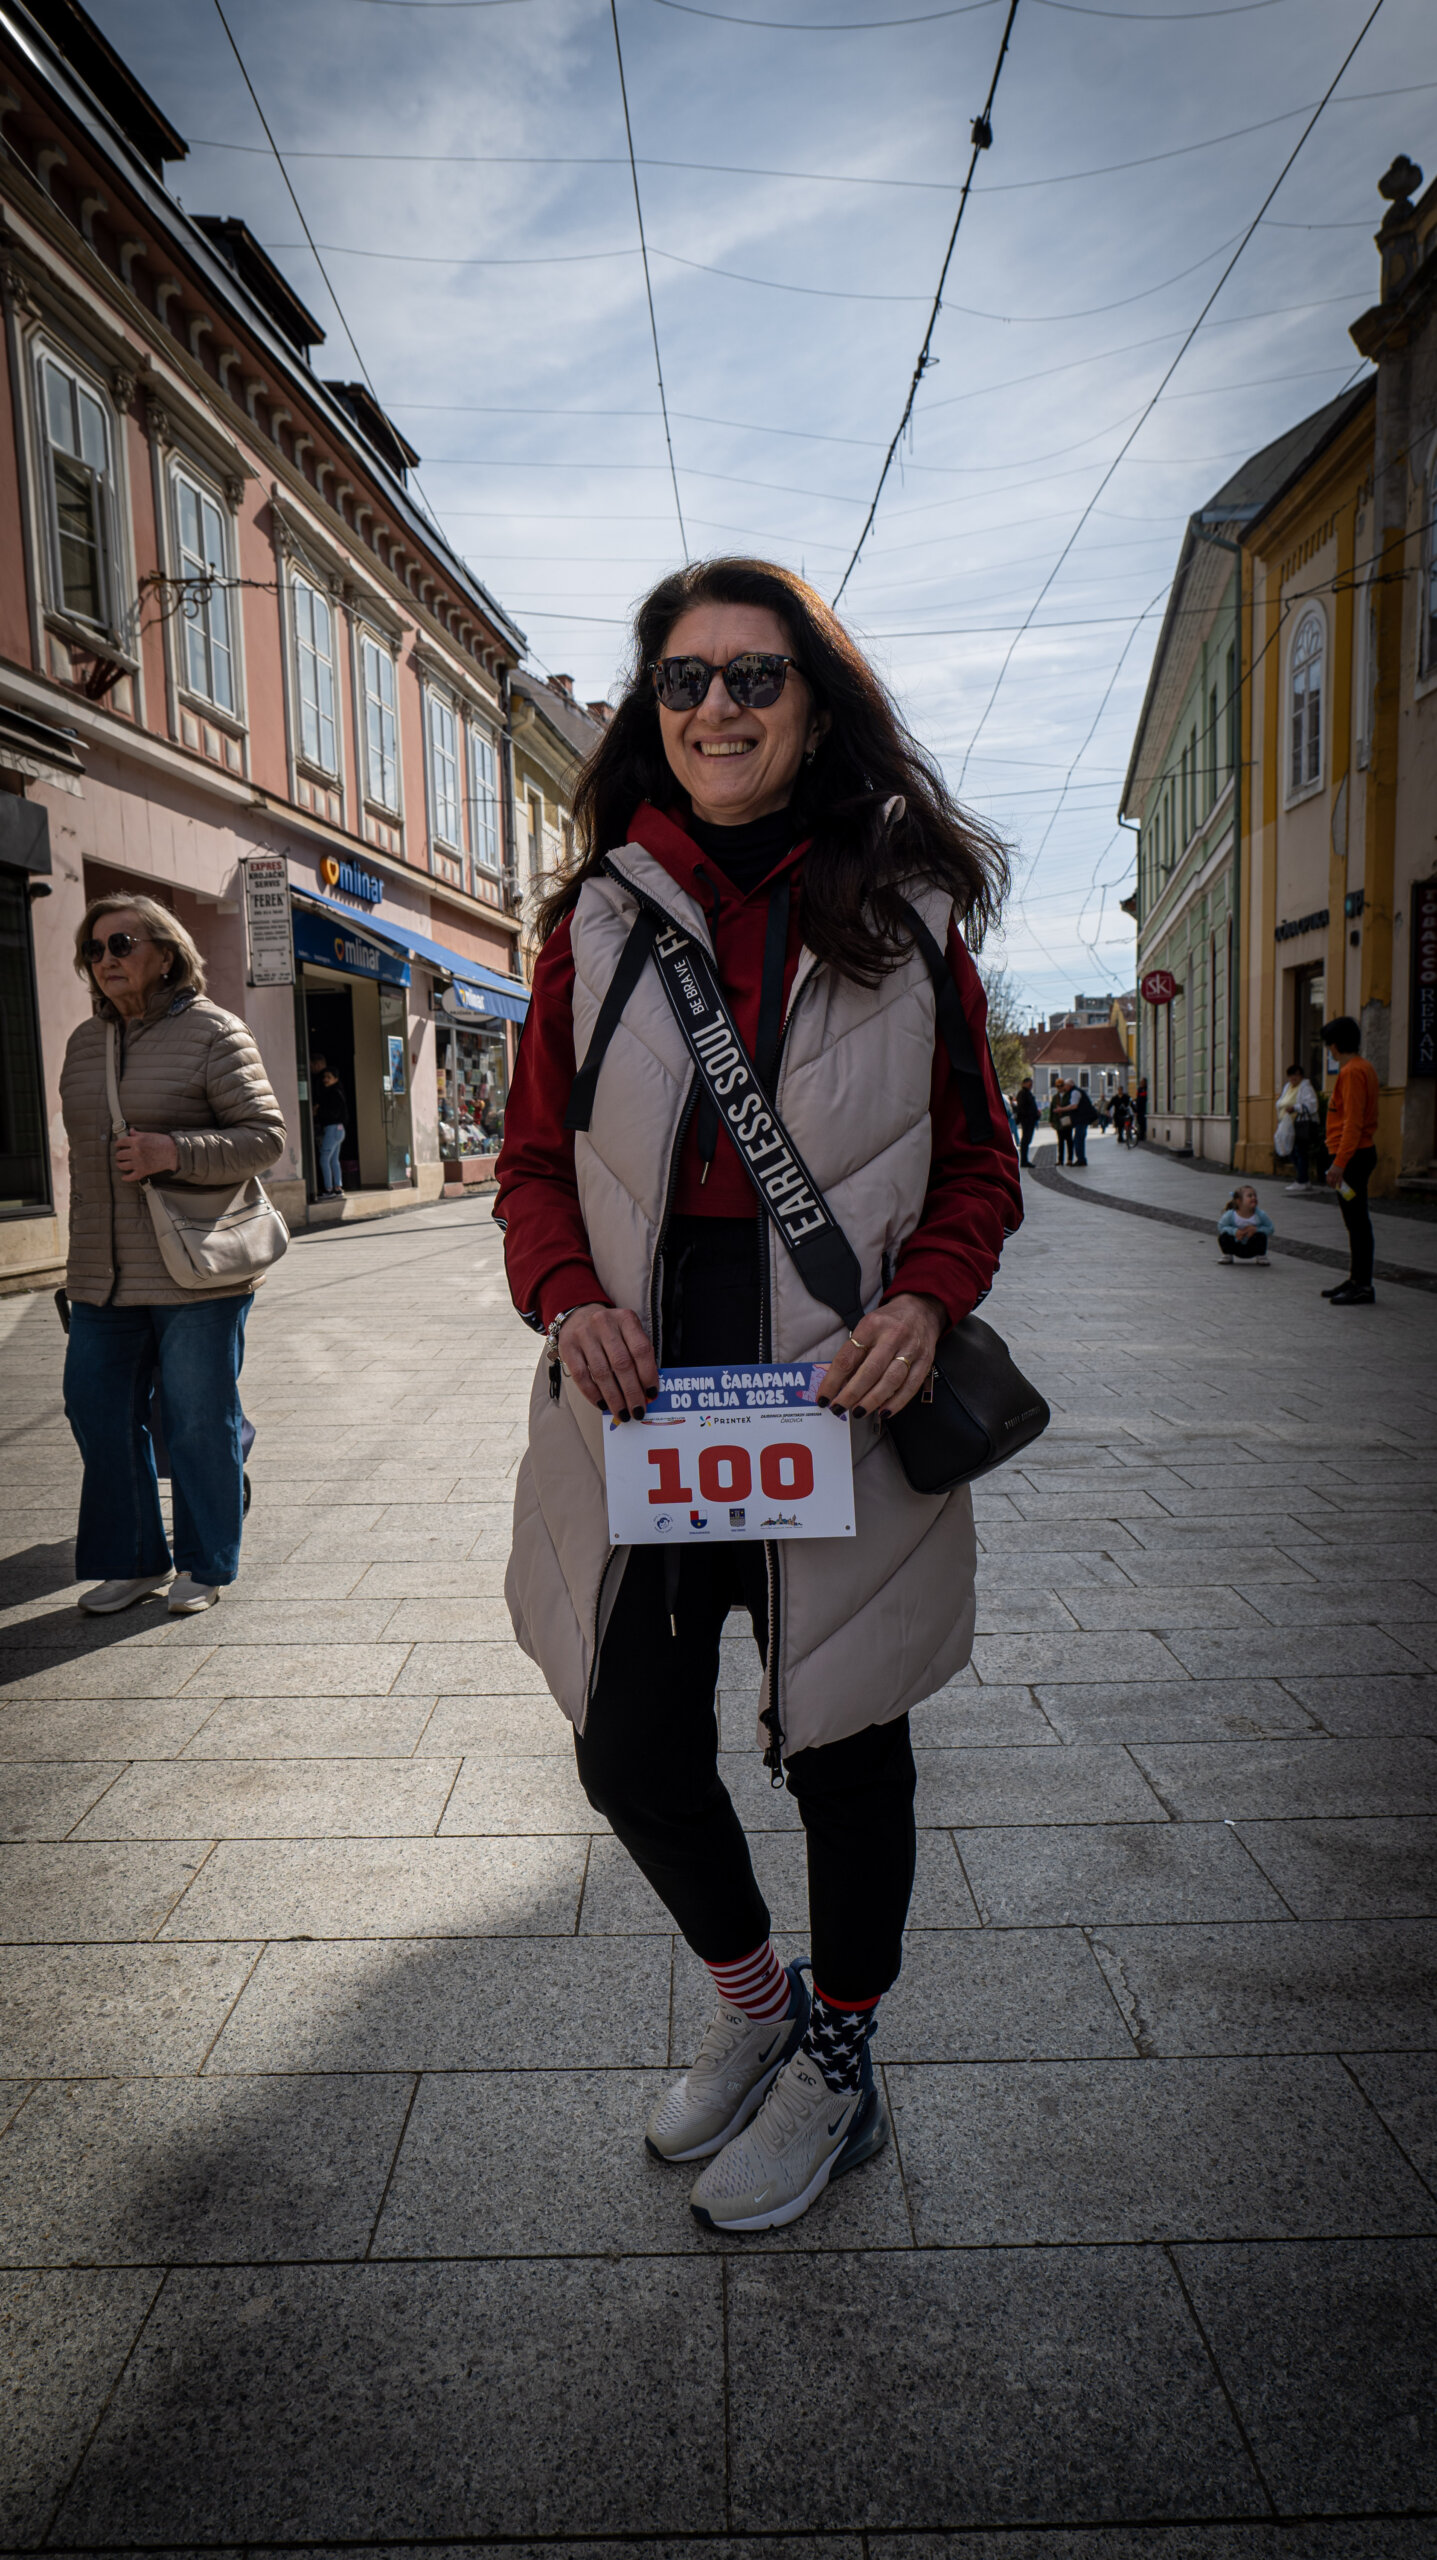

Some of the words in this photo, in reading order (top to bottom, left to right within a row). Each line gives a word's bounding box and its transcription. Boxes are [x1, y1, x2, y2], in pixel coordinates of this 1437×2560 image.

[250, 862, 282, 871] EXPRES
[254, 880, 280, 888] SERVIS
[339, 860, 384, 904] mlinar
[345, 938, 380, 971] mlinar
[673, 959, 701, 999] BRAVE
[689, 1000, 705, 1016] BE
[1419, 987, 1435, 1064] REFAN
[691, 1009, 749, 1096] SOUL
[727, 1092, 827, 1246] EARLESS
[721, 1370, 805, 1390] ČARAPAMA
[671, 1393, 692, 1409] DO
[698, 1391, 740, 1408] CILJA
[746, 1389, 788, 1406] 2025.
[647, 1442, 815, 1504] 100
